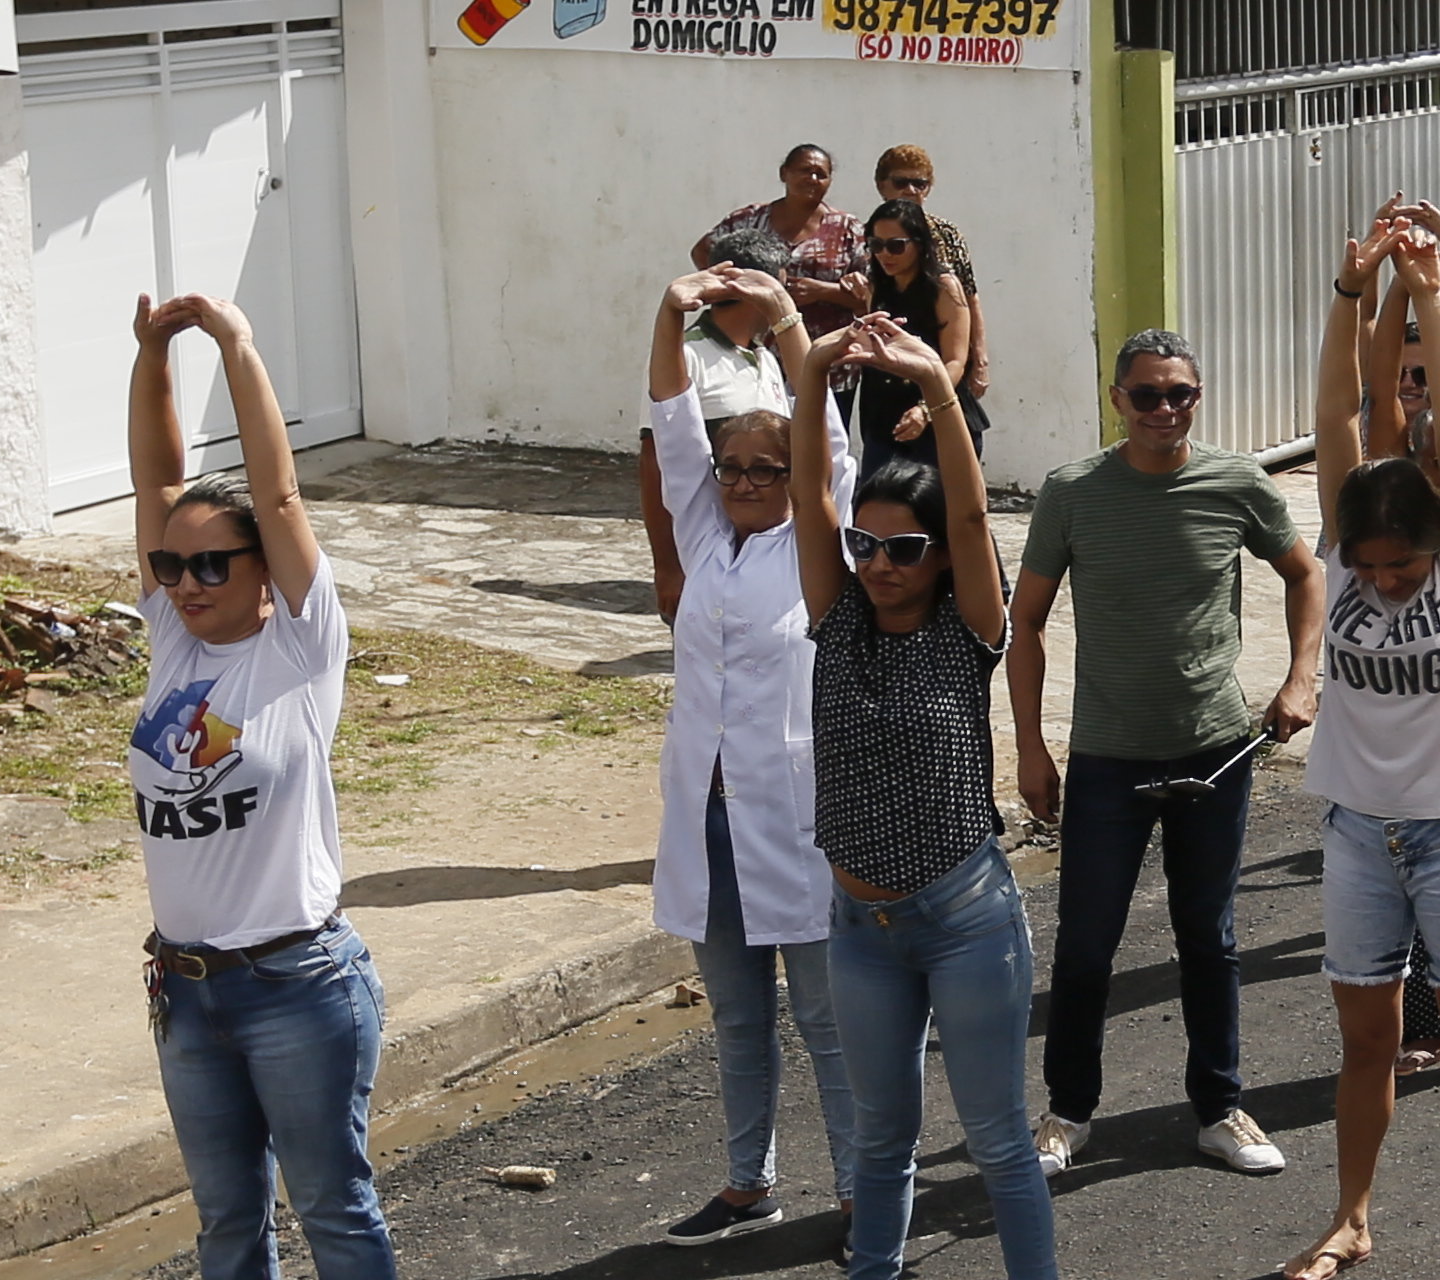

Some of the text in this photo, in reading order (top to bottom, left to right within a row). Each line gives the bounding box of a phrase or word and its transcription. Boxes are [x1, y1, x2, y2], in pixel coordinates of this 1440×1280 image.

[900, 36, 933, 61] NO
[937, 35, 1023, 66] BAIRRO)
[1329, 580, 1382, 645] WE
